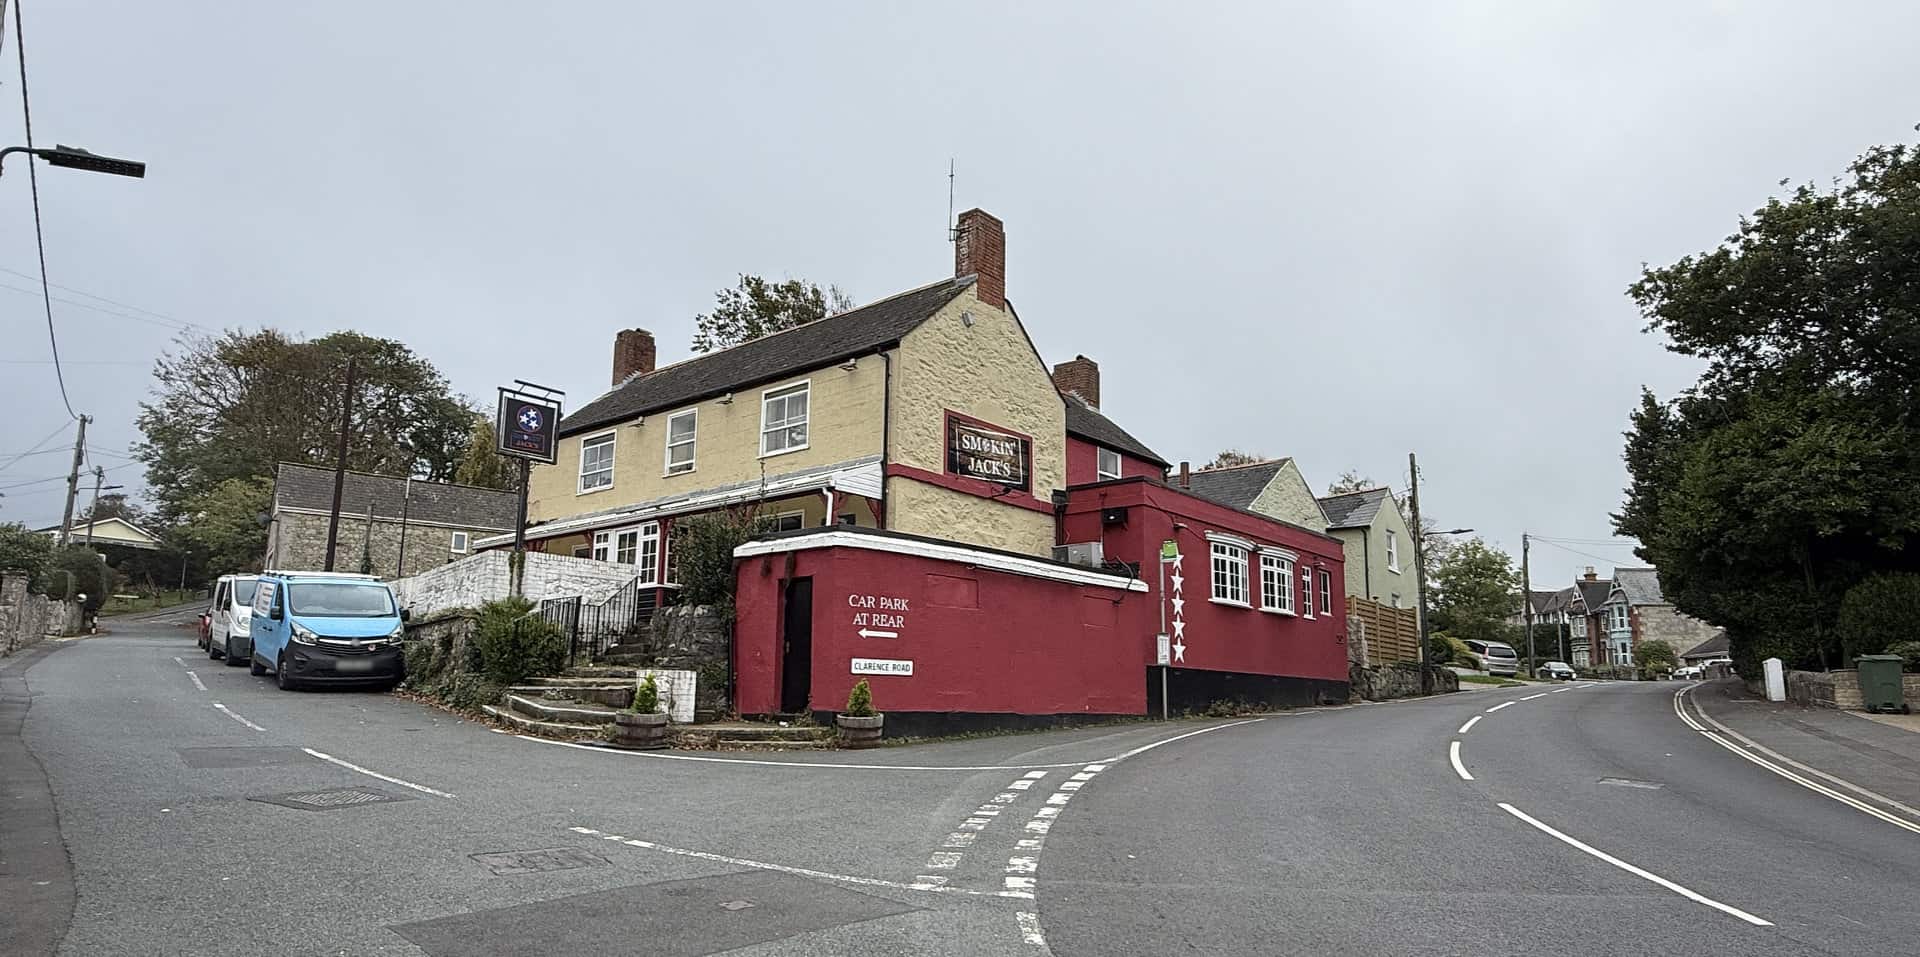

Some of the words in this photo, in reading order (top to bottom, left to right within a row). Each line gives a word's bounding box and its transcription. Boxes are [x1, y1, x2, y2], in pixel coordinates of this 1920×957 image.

[968, 457, 1011, 477] JACK'S
[848, 594, 876, 608] CAR
[880, 596, 910, 611] PARK
[852, 612, 869, 625] AT
[872, 613, 904, 628] REAR
[854, 662, 889, 671] CLARENCE
[892, 663, 910, 672] ROAD
